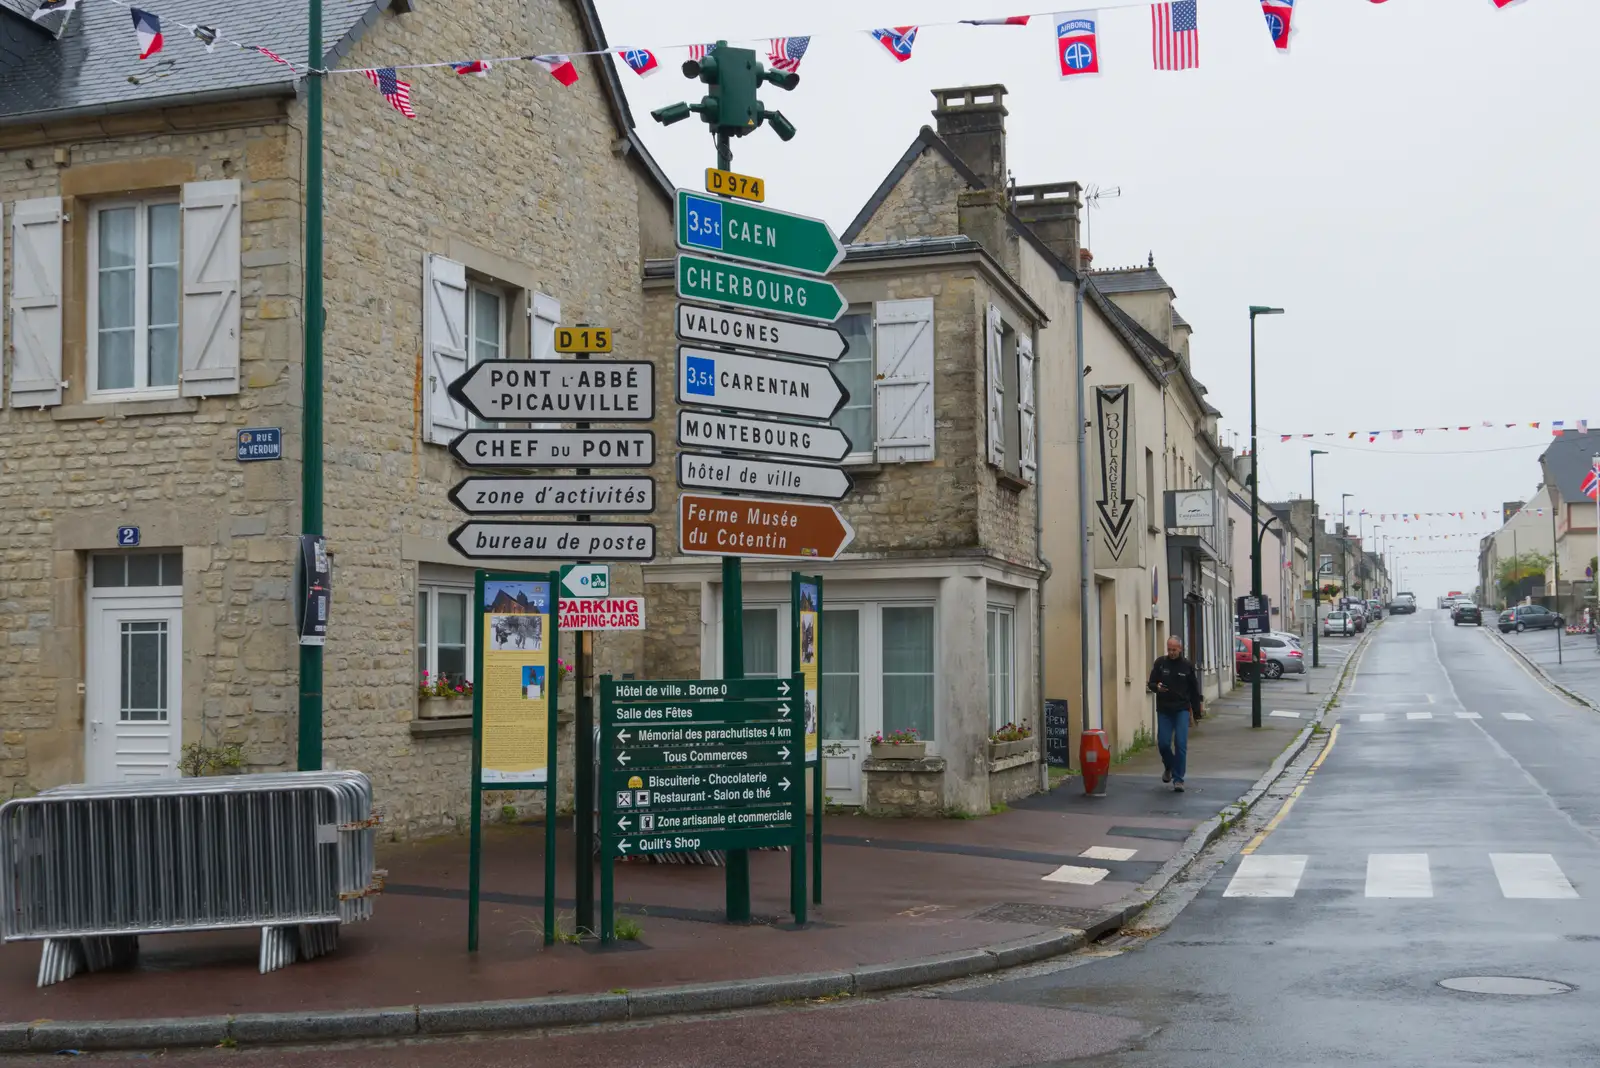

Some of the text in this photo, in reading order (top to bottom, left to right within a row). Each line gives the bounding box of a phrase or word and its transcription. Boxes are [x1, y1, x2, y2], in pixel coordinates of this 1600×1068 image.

[1060, 21, 1092, 34] AIRBORNE
[713, 172, 760, 197] D 974
[689, 210, 776, 248] 3,5t CAEN
[686, 266, 807, 307] CHERBOURG
[686, 313, 780, 343] VALOGNES
[560, 331, 607, 348] D 15
[491, 370, 551, 387] PONT
[687, 367, 810, 399] 3,5t CARENTAN
[491, 393, 640, 411] -PICAUVILLE
[256, 433, 273, 442] RUE
[686, 420, 811, 449] MONTEBOURG
[239, 444, 279, 455] de VERDUN
[475, 440, 645, 457] CHEF DU PONT
[1105, 412, 1120, 518] BOULANGERIE
[687, 462, 801, 488] hôtel de ville
[476, 486, 646, 504] zone d'activités
[688, 503, 798, 528] Ferme Musée
[123, 528, 134, 543] 2
[476, 531, 646, 554] bureau de poste
[689, 527, 787, 549] du Cotentin
[558, 600, 638, 613] PARKING
[616, 684, 643, 697] Hôtel
[645, 685, 658, 697] de
[660, 684, 681, 696] ville
[689, 684, 719, 696] Borne
[721, 684, 728, 695] 0
[616, 706, 693, 720] Salle des Fêtes
[638, 726, 791, 742] Mémorial des parachutistes 4 km
[663, 750, 748, 763] Tous Commerces
[649, 775, 700, 787] Biscuiterie
[708, 772, 767, 785] Chocolaterie
[653, 790, 705, 803] Restaurant
[714, 789, 741, 801] Salon
[742, 788, 754, 800] de
[756, 786, 771, 799] thé
[657, 810, 792, 827] Zone artisanale et commerciale
[639, 836, 700, 851] Quilt's Shop
